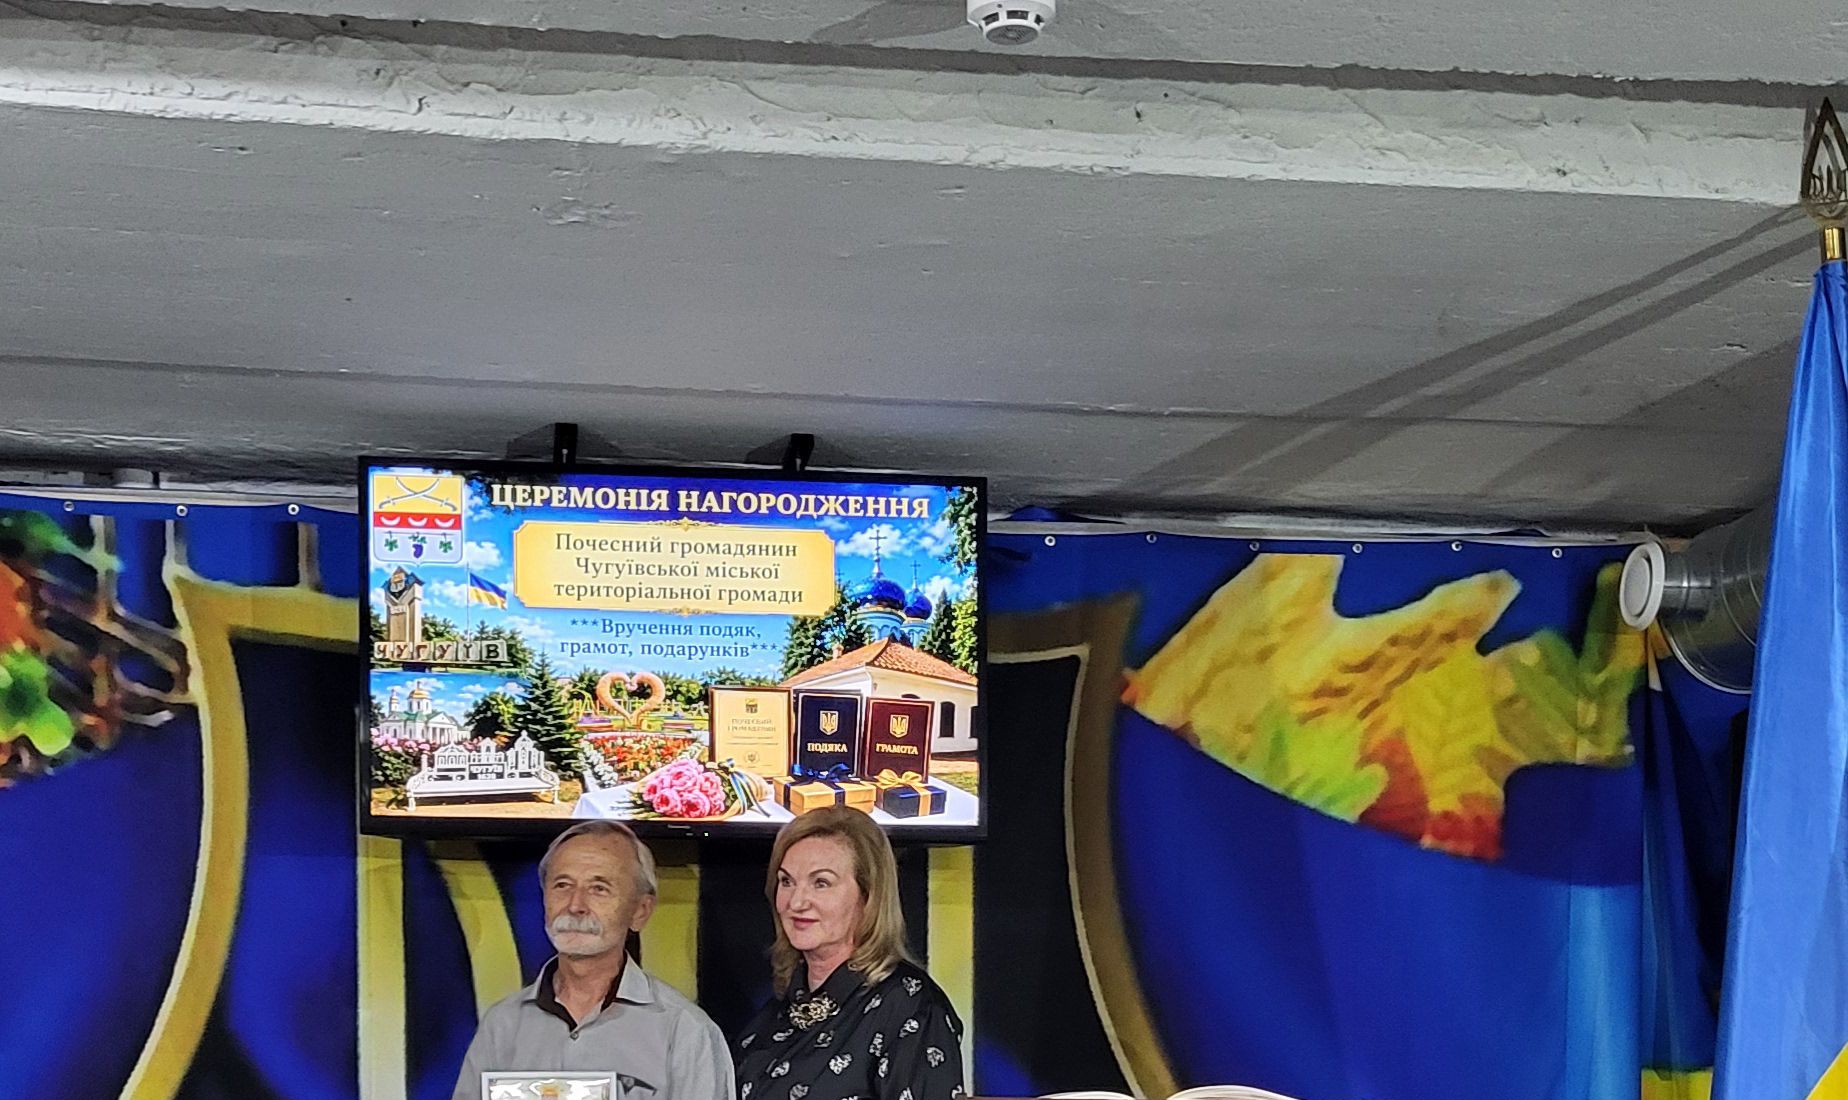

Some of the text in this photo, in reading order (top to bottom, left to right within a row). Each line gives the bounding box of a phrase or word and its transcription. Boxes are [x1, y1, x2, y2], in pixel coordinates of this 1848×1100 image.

[491, 483, 930, 518] ЦЕРЕМОНІЯ НАГОРОДЖЕННЯ
[556, 533, 798, 558] Почесний громадянин
[576, 556, 780, 580] Чугуївської міської
[554, 582, 803, 604] територіальної громади
[699, 625, 761, 640] подяк,
[560, 641, 633, 657] грамот,
[807, 742, 848, 754] ПОДЯКА
[875, 743, 919, 755] ГРАМОТА
